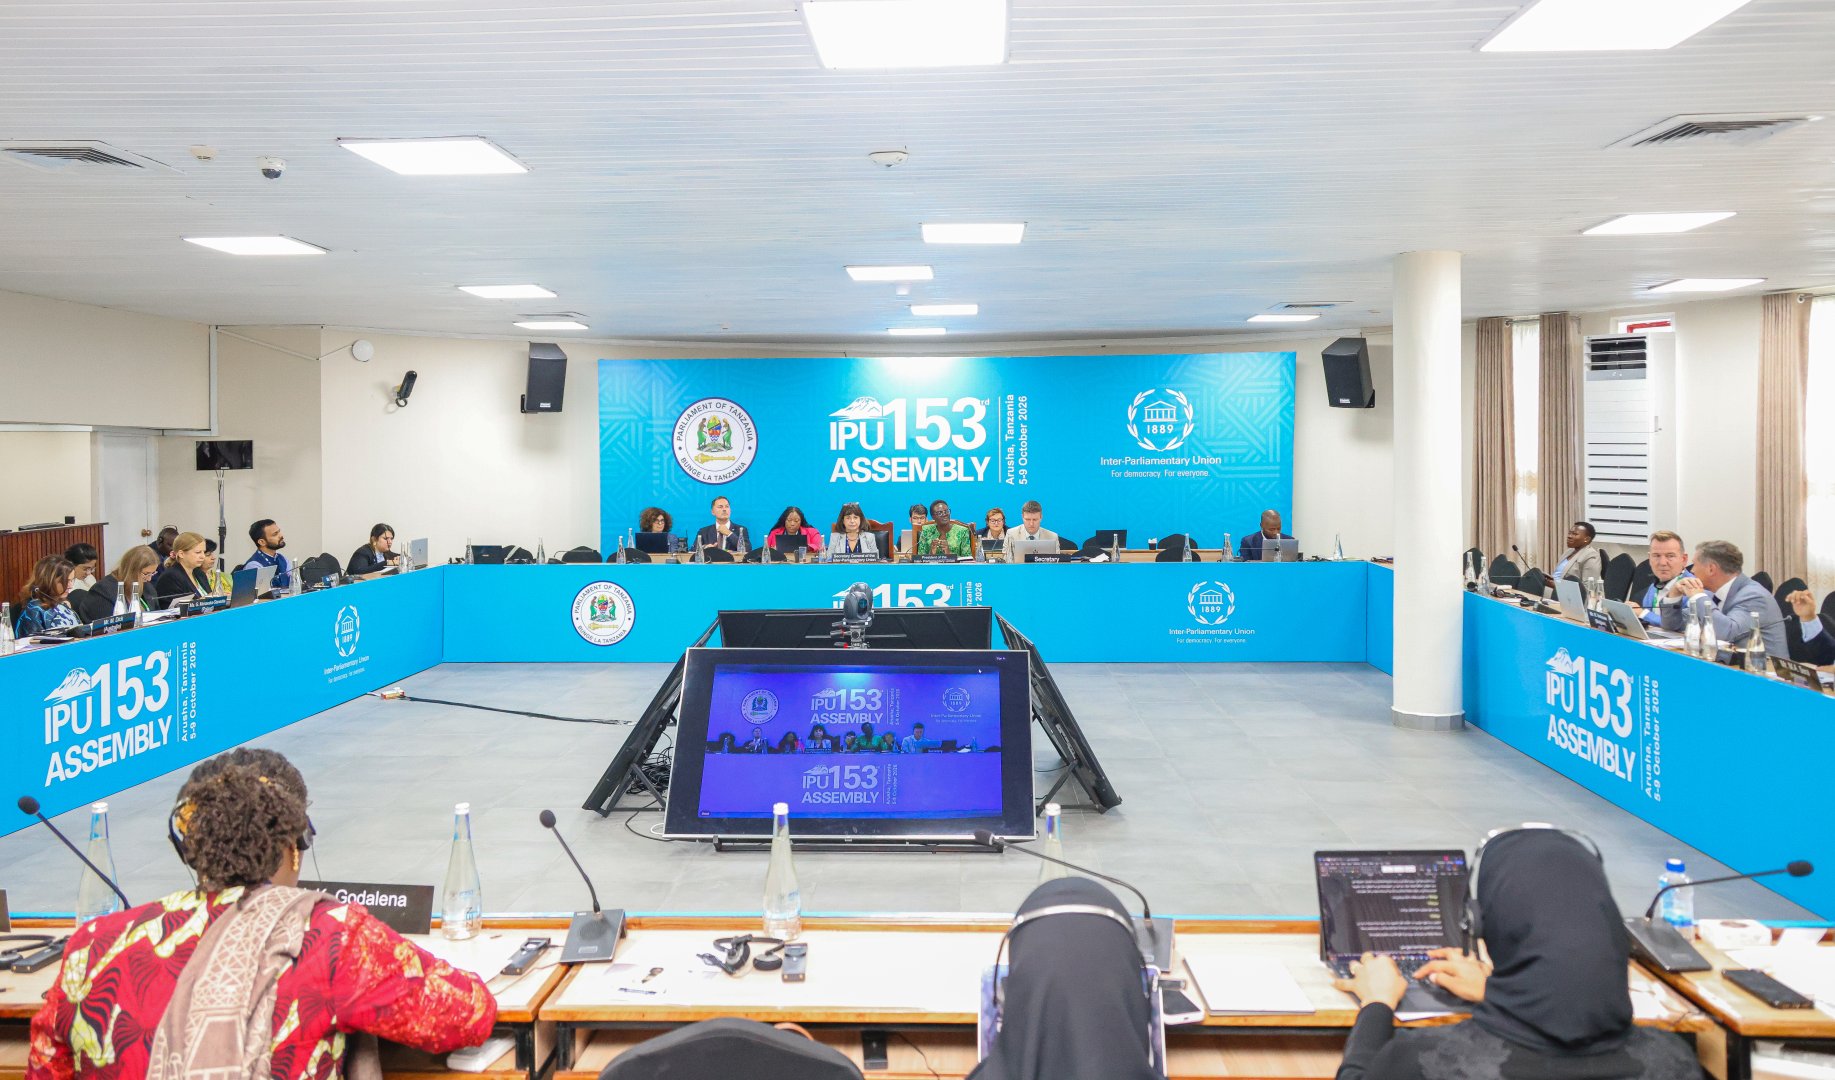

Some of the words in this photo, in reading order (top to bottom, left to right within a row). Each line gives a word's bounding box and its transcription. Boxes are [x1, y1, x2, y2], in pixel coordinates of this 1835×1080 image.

[1004, 394, 1014, 442] Tanzania
[1018, 396, 1028, 420] 2026
[676, 402, 713, 441] PARLIAMENT
[728, 405, 754, 442] TANZANIA
[1146, 424, 1174, 434] 1889
[830, 421, 885, 450] IPU
[1018, 423, 1028, 466] October
[681, 457, 702, 478] BUNGE
[714, 462, 747, 482] TANZANIA
[830, 456, 991, 482] ASSEMBLY
[1005, 444, 1016, 485] Arusha,
[1100, 456, 1190, 466] Inter-Parliamentary
[1192, 456, 1222, 465] Union
[1111, 470, 1122, 478] For
[1164, 469, 1175, 477] For
[1018, 469, 1028, 485] 5-9
[974, 582, 983, 602] 2026
[810, 698, 836, 711] IPU
[1546, 671, 1574, 714] IPU
[1652, 680, 1660, 714] 2026
[44, 696, 93, 744] IPU
[810, 712, 884, 724] ASSEMBLY
[44, 714, 172, 787] ASSEMBLY
[1547, 714, 1636, 782] ASSEMBLY
[1652, 718, 1660, 776] October
[802, 775, 829, 789] IPU
[801, 792, 880, 804] ASSEMBLY
[336, 889, 408, 907] Godalena
